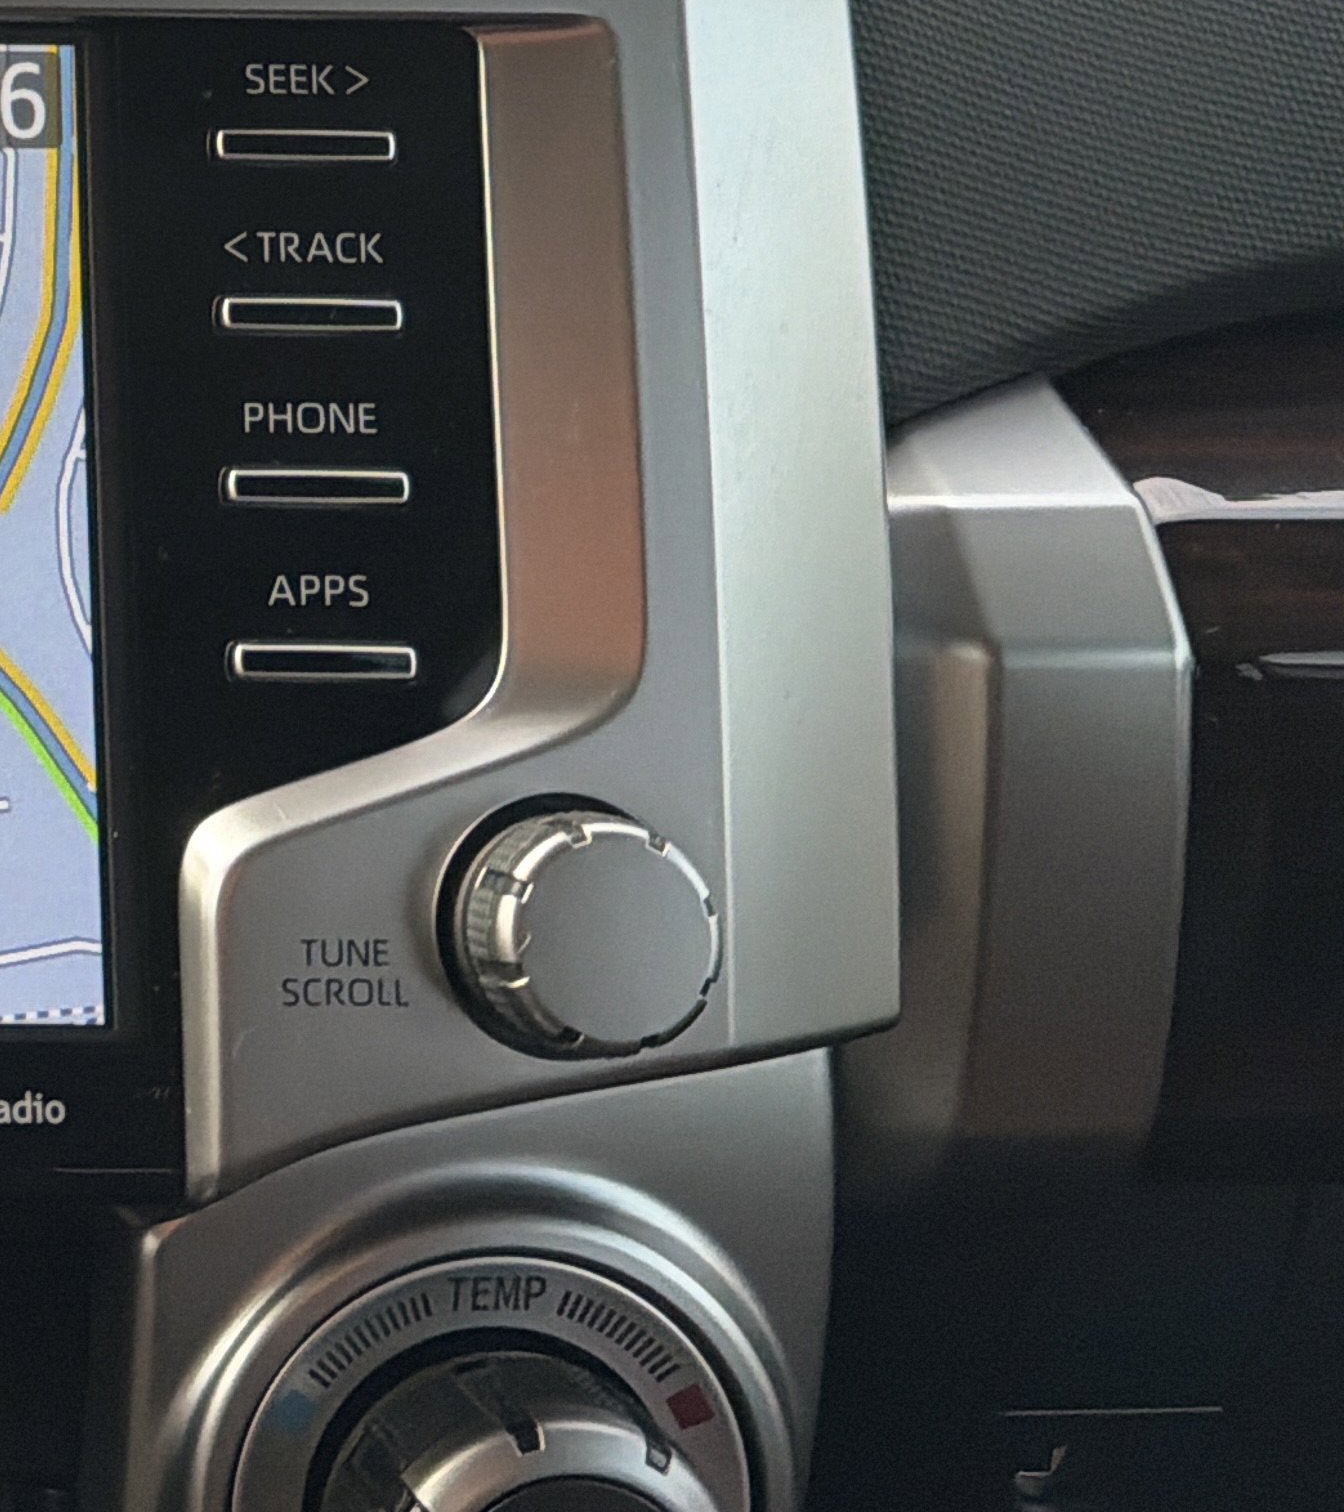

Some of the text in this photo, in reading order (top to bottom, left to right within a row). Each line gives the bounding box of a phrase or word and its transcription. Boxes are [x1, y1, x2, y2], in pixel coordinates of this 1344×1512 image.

[244, 63, 335, 96] SEEK
[257, 231, 384, 264] TRACK
[243, 402, 379, 434] PHONE
[267, 575, 371, 608] APPS
[300, 939, 389, 967] TUNE
[281, 978, 409, 1007] SCROLL
[447, 1275, 547, 1313] TEMP
